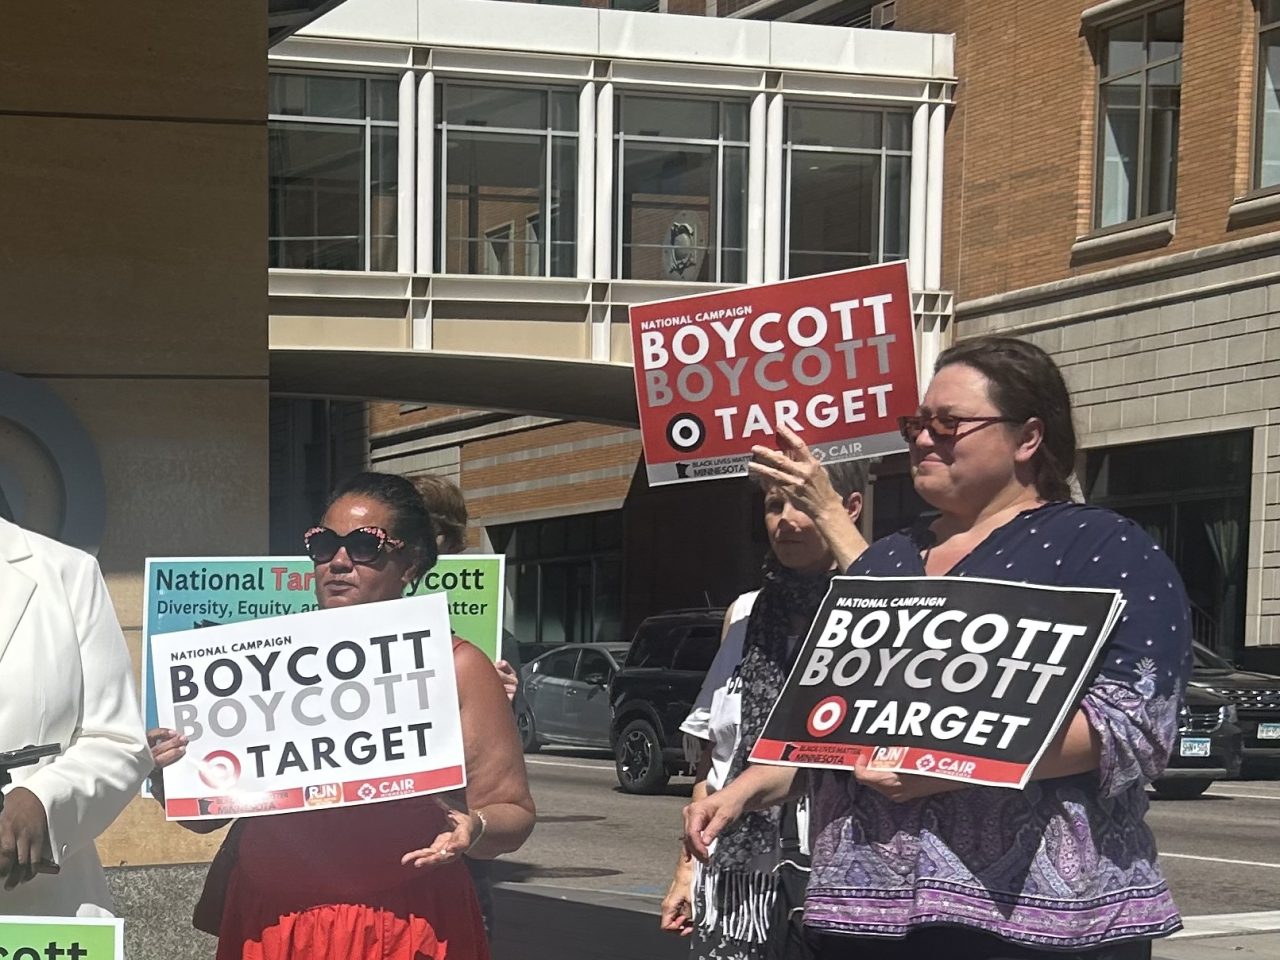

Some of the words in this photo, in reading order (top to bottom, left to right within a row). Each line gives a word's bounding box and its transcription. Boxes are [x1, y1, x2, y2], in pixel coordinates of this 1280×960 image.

[641, 315, 693, 330] NATIONAL
[695, 305, 753, 322] CAMPAIGN
[641, 293, 893, 370] BOYCOTT
[645, 334, 896, 407] BOYCOTT
[714, 384, 893, 440] TARGET
[829, 443, 862, 456] CAIR
[692, 460, 713, 468] BLACK
[694, 464, 746, 477] MINNESOTA
[156, 567, 264, 592] National
[271, 567, 316, 591] Tar
[406, 568, 484, 596] ycott
[157, 600, 232, 618] Diversity,
[448, 602, 488, 615] tter
[836, 597, 888, 607] NATIONAL
[890, 597, 946, 607] CAMPAIGN
[170, 646, 228, 661] NATIONAL
[231, 635, 292, 652] CAMPAIGN
[816, 609, 1087, 665] BOYCOTT
[170, 629, 431, 703] BOYCOTT
[799, 648, 1066, 704] BOYCOTT
[172, 669, 435, 742] BOYCOTT
[850, 699, 1030, 749] TARGET
[247, 722, 433, 778] TARGET
[876, 748, 899, 760] RJN
[938, 758, 976, 773] CAIR
[309, 786, 337, 799] RJN
[379, 779, 414, 794] CAIR
